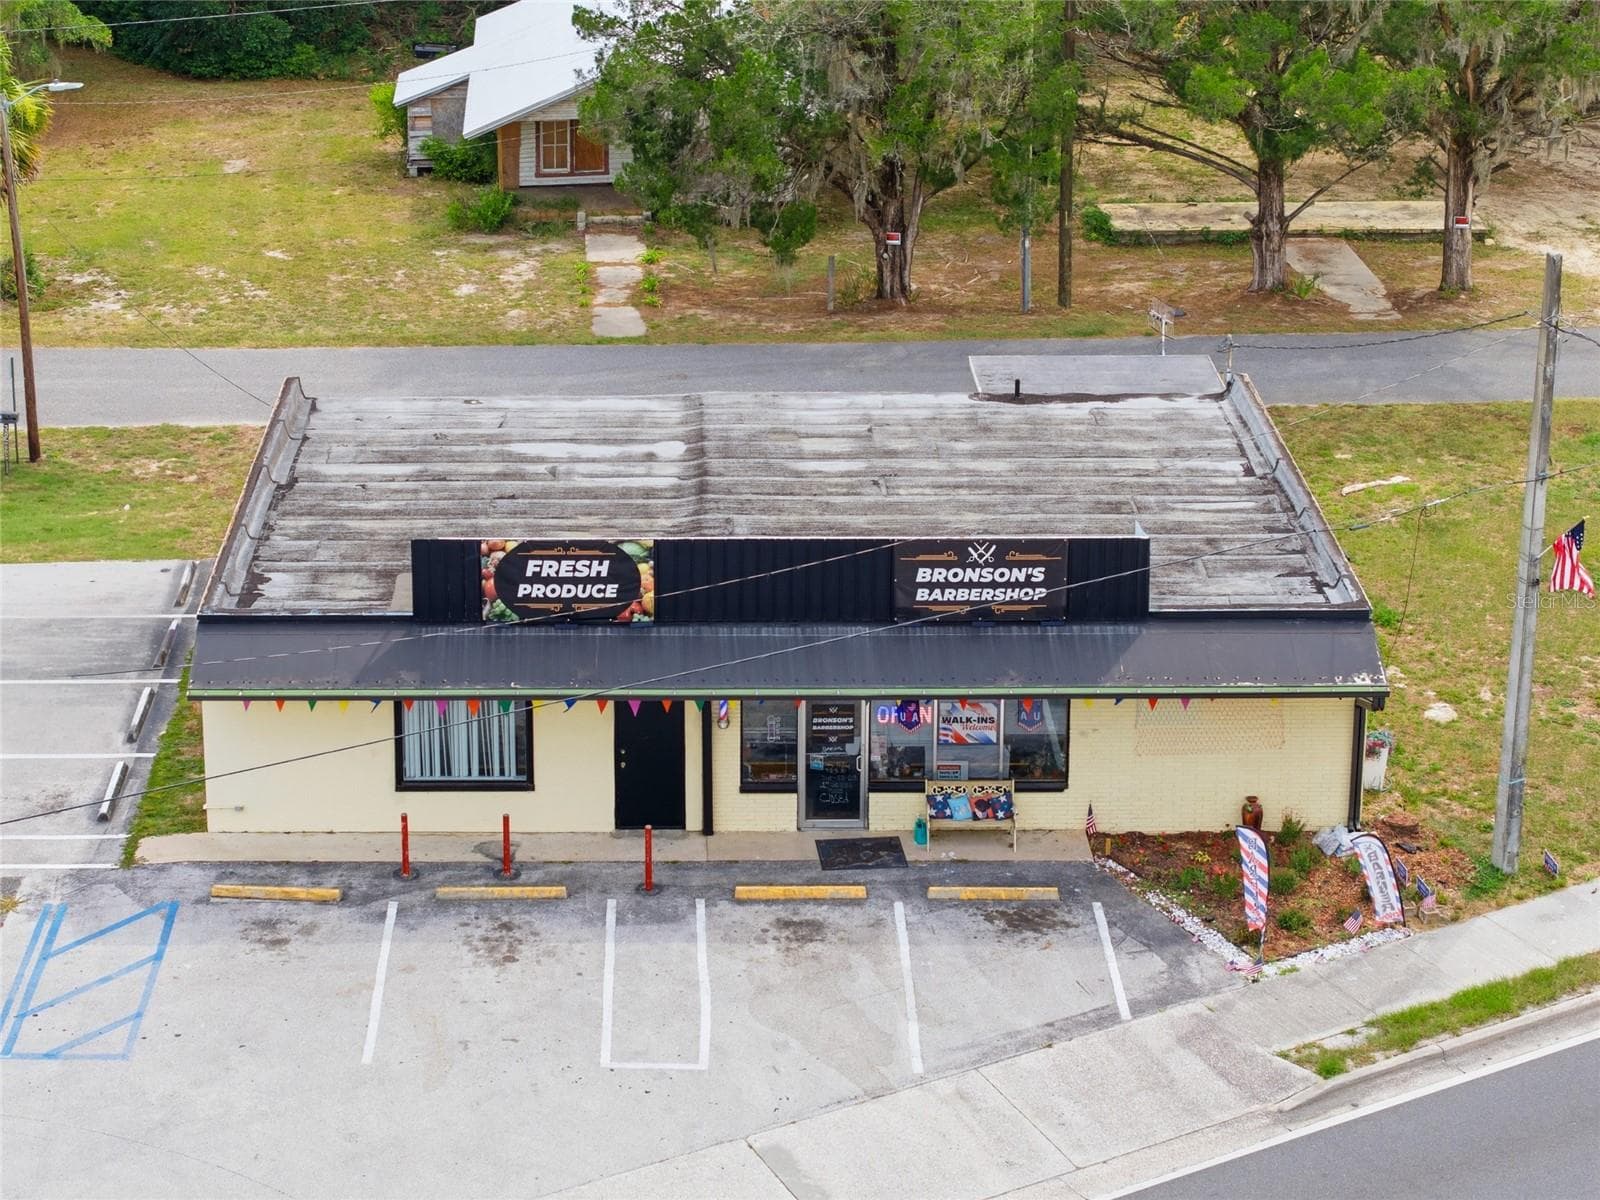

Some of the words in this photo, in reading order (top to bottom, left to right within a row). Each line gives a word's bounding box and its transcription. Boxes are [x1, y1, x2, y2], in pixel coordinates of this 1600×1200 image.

[525, 560, 609, 577] FRESH
[915, 567, 1046, 583] BRONSON'S
[517, 584, 619, 598] PRODUCE
[915, 588, 1047, 601] BARBERSHOP
[942, 716, 996, 724] WALK-INS
[962, 723, 998, 732] Welcome
